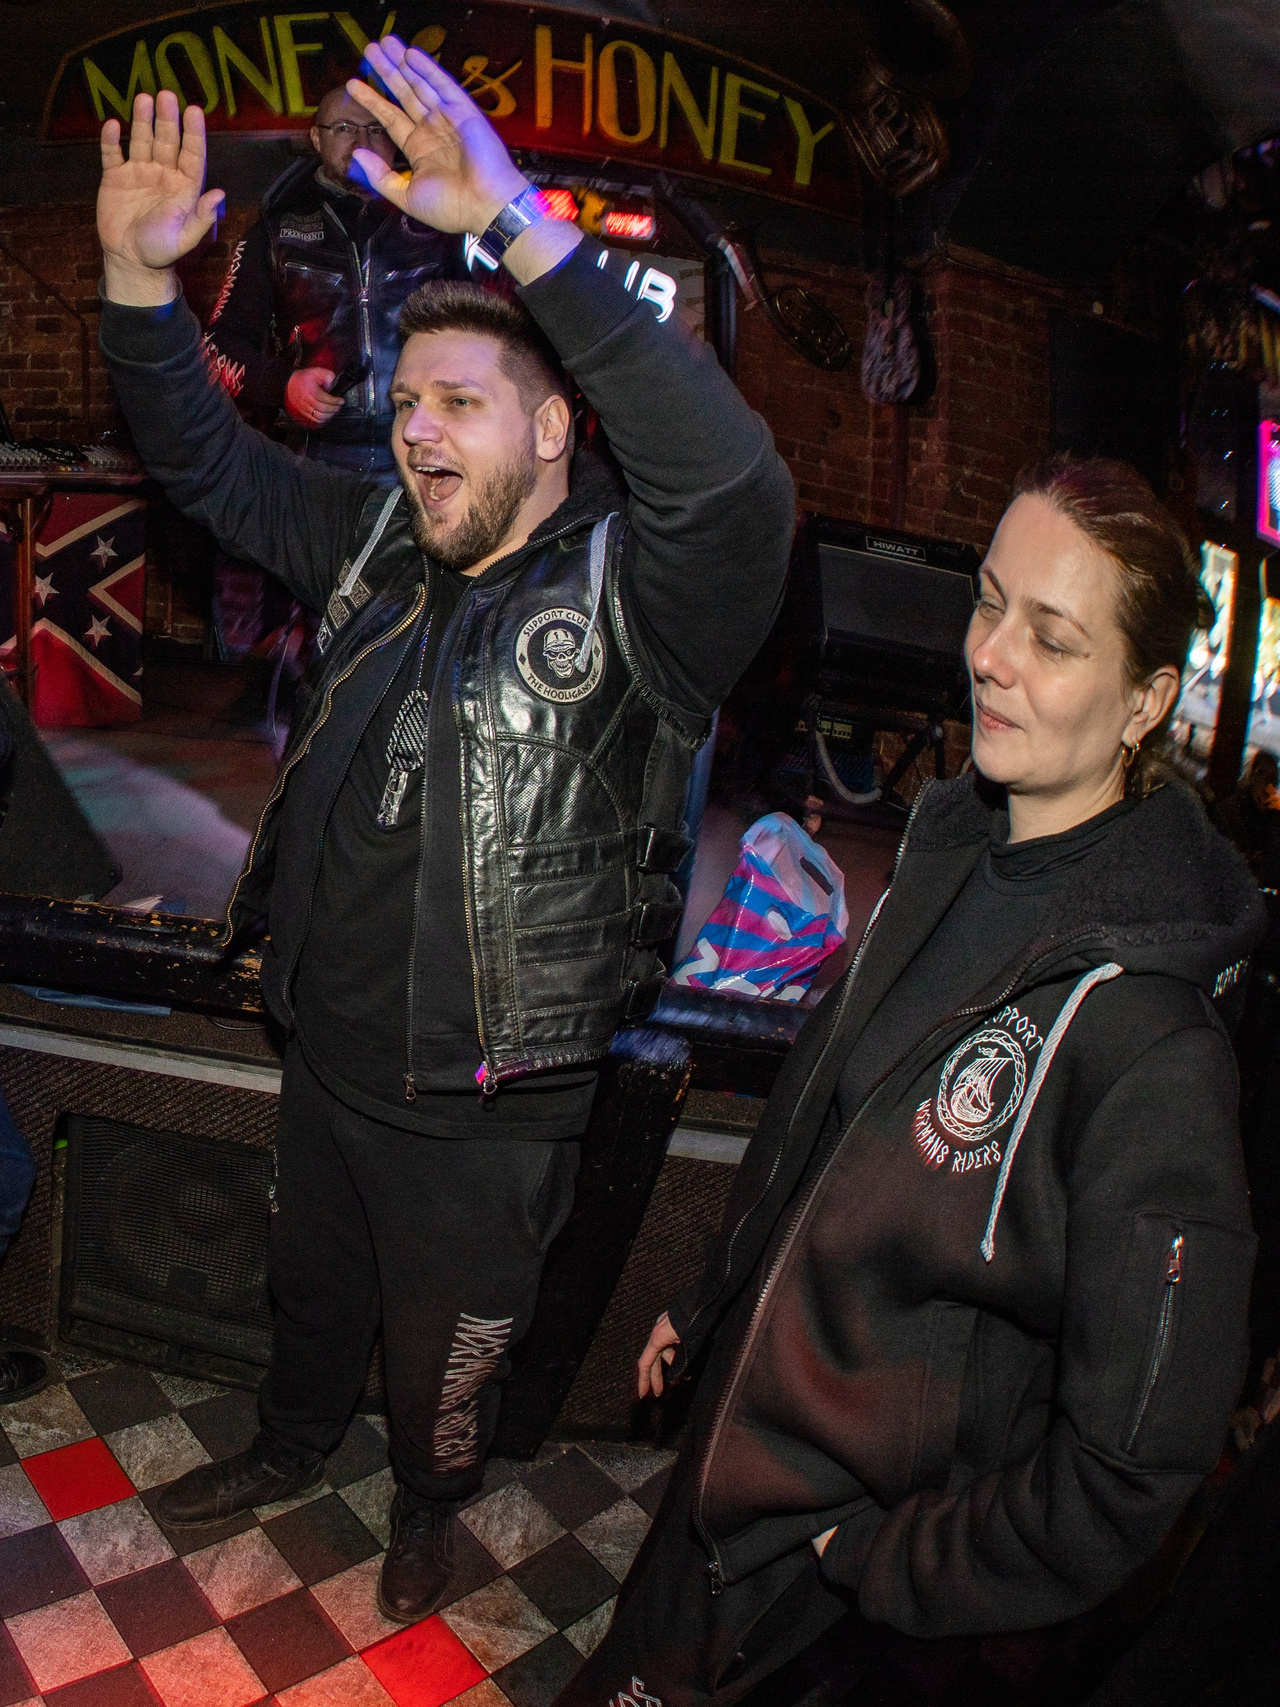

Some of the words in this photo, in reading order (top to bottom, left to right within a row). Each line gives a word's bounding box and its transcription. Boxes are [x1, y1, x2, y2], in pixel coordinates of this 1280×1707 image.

[83, 10, 397, 123] MONEY
[534, 24, 835, 187] HONEY
[873, 540, 919, 556] HIWATT
[523, 610, 564, 637] SUPPORT
[565, 612, 590, 630] CLUB
[527, 672, 545, 692] THE
[543, 682, 593, 700] HOOLIGANS
[983, 1005, 1045, 1051] UPPORT
[951, 1140, 1001, 1173] RIDERS
